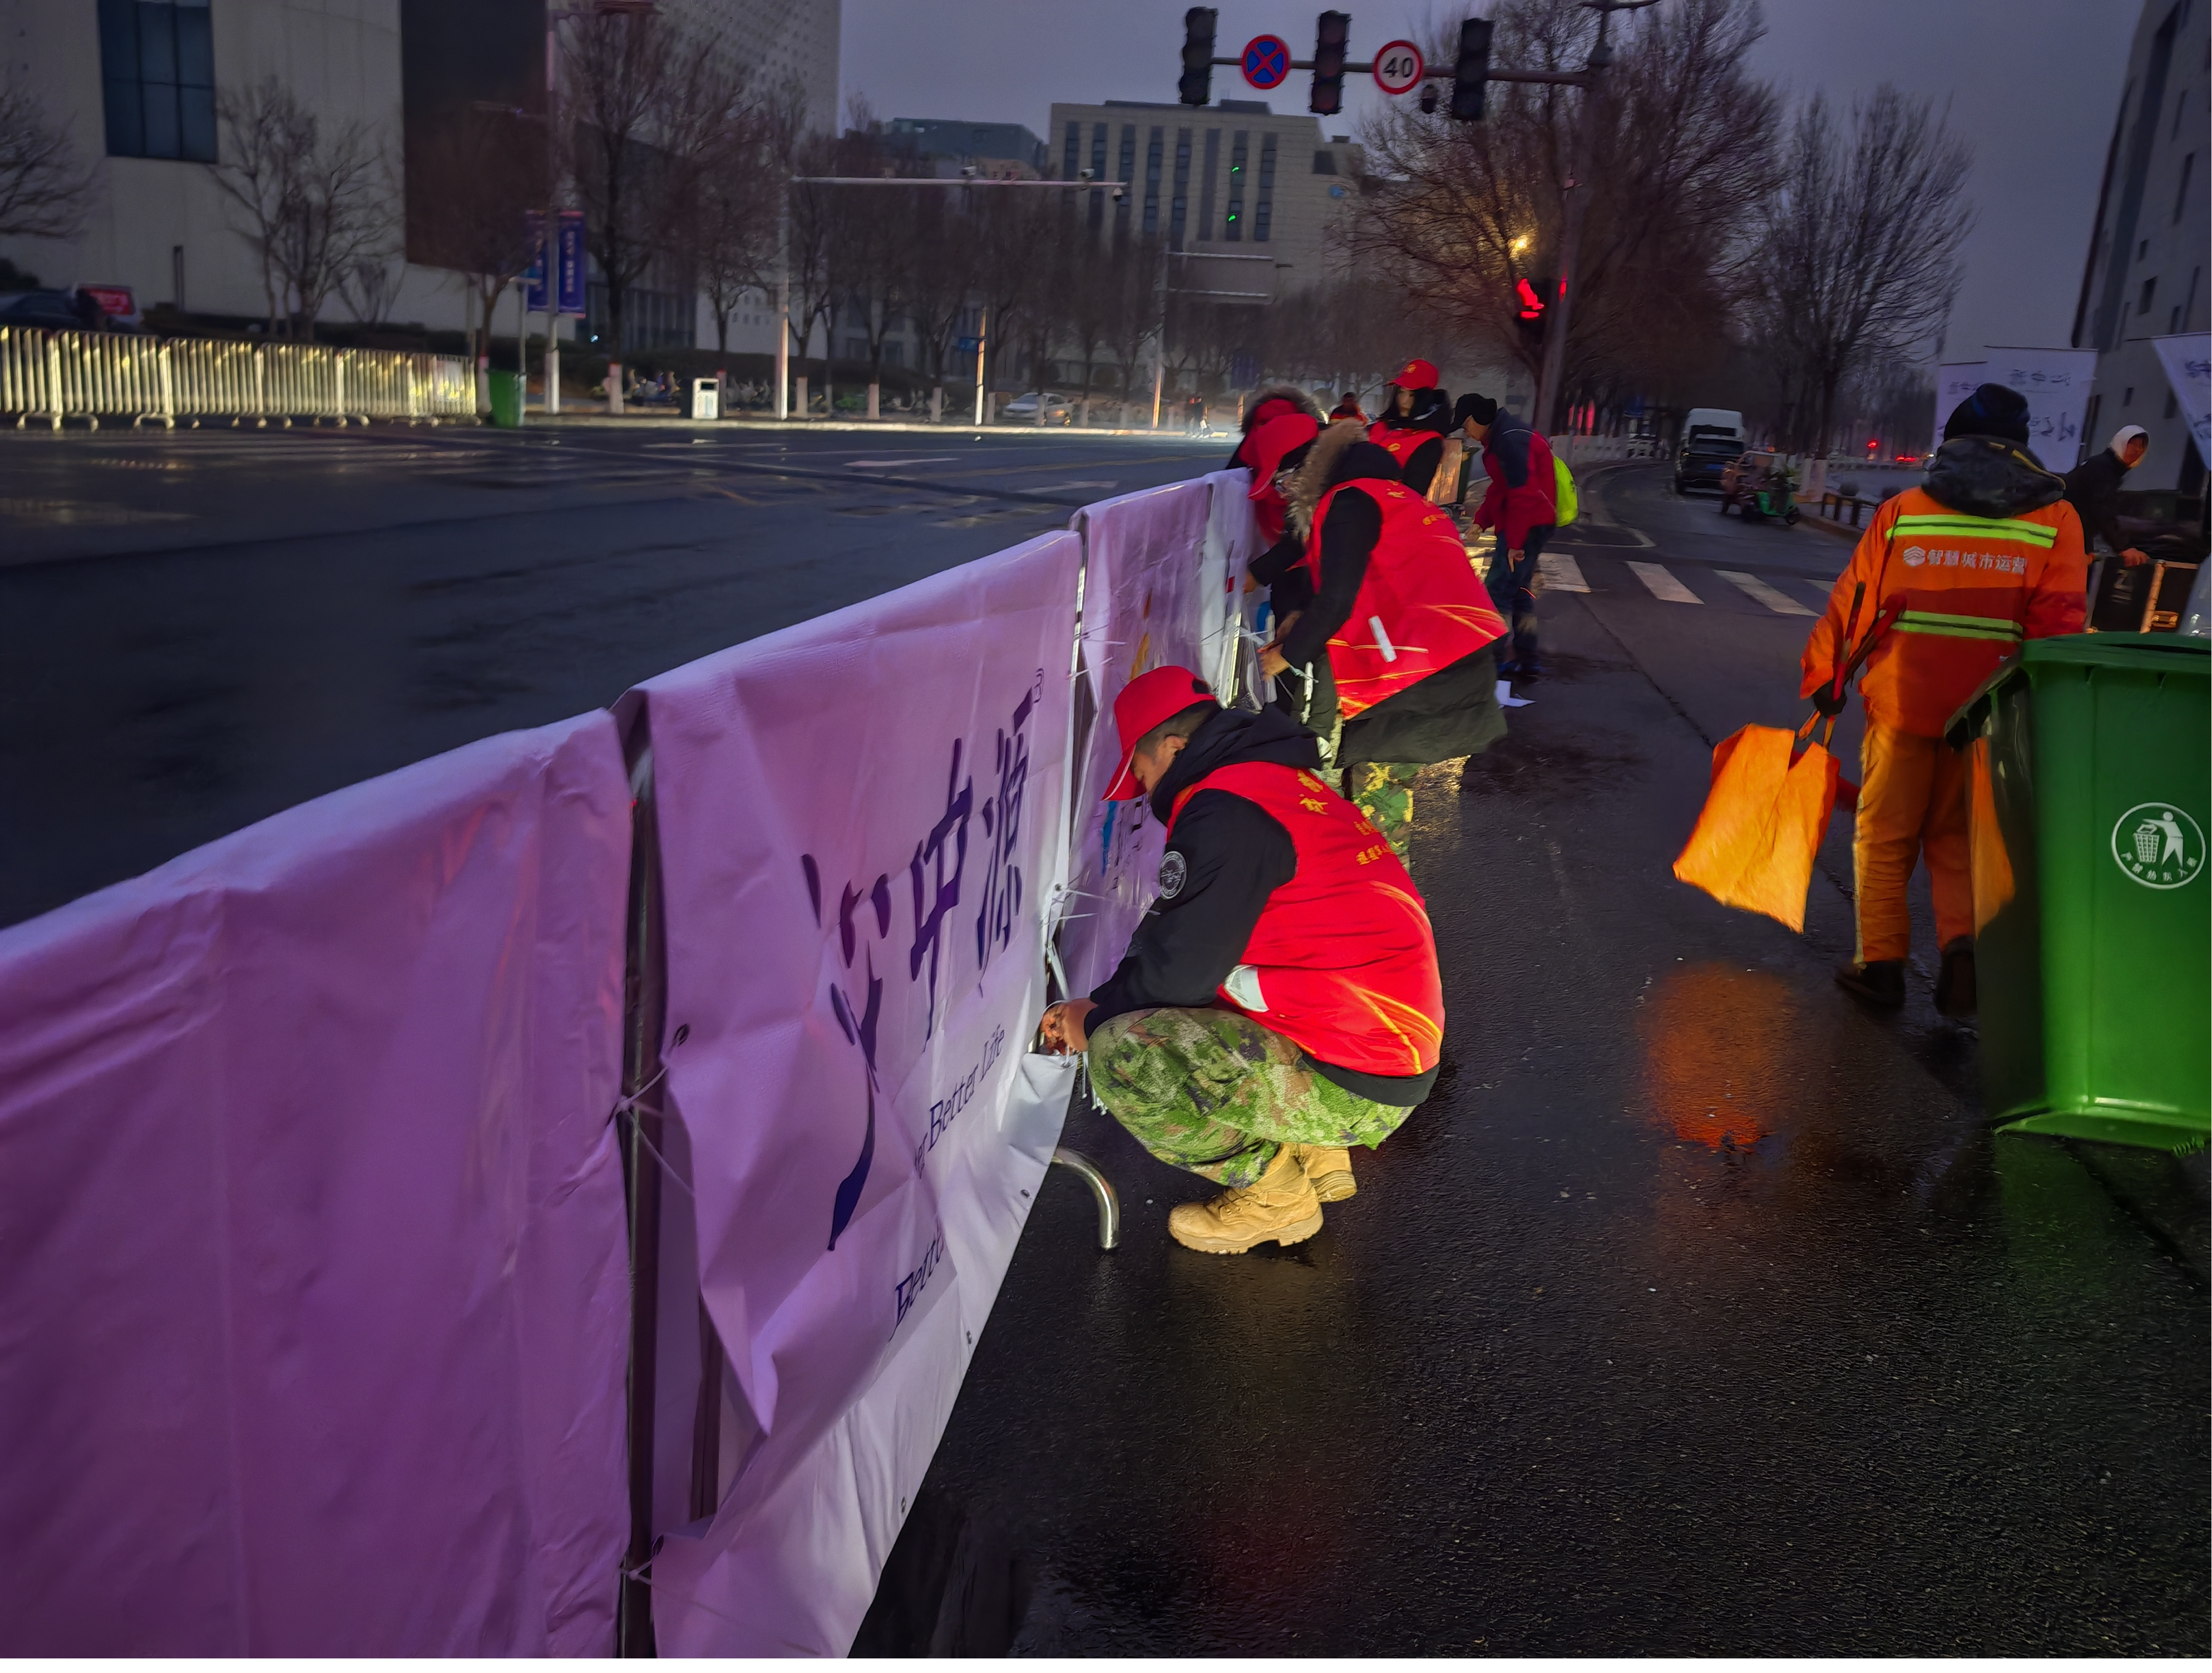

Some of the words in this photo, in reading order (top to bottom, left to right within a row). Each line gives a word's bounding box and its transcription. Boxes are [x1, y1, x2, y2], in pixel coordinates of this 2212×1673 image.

[1383, 57, 1413, 78] 40
[927, 1064, 979, 1152] Better
[979, 1023, 1005, 1082] Life
